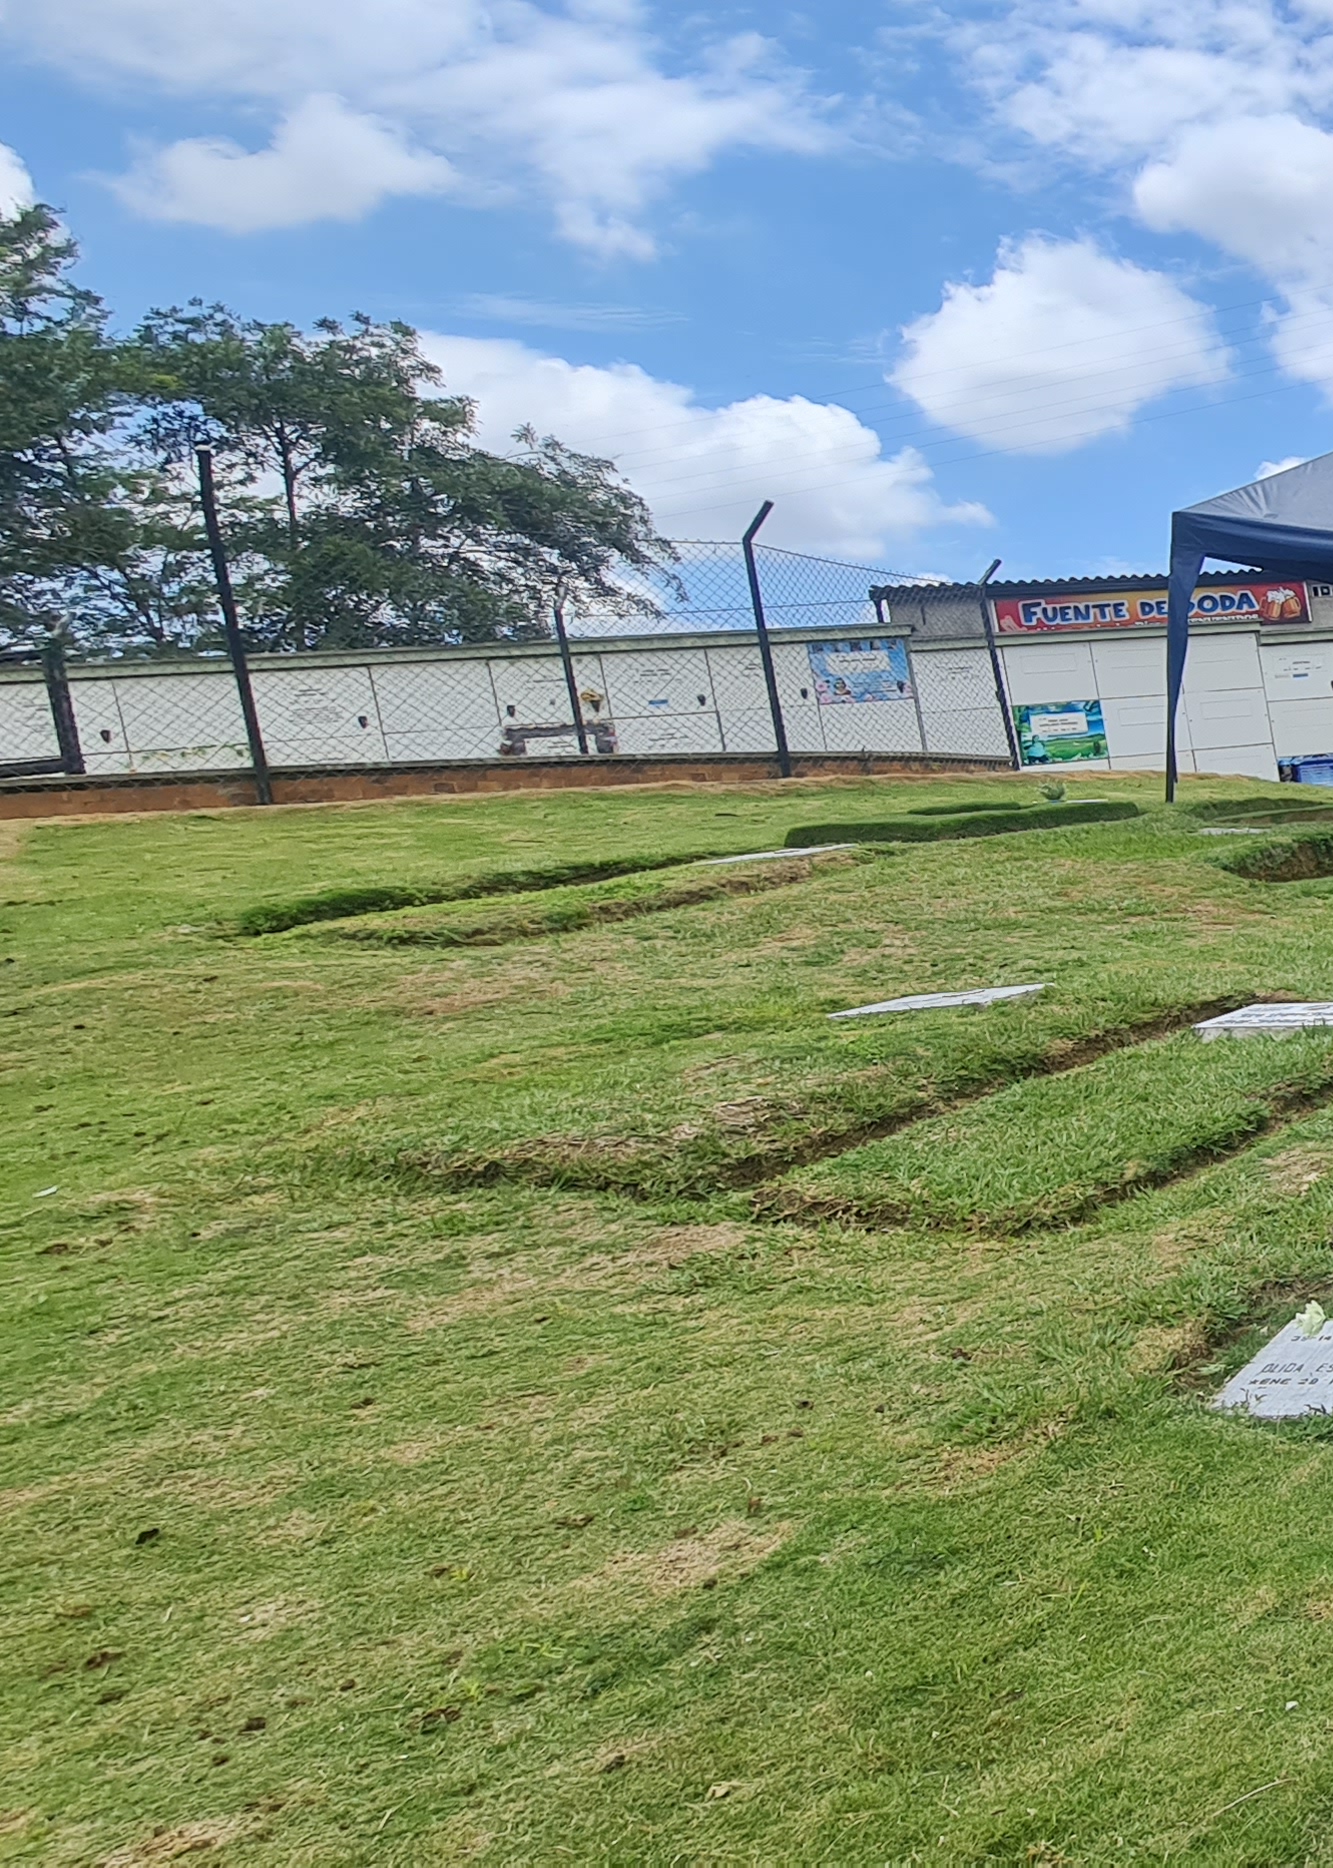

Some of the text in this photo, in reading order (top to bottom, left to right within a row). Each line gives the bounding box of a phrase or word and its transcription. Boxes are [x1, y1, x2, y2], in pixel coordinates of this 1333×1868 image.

[1018, 600, 1128, 625] FUENTE
[1137, 598, 1168, 620] DE
[1187, 590, 1260, 615] ODA
